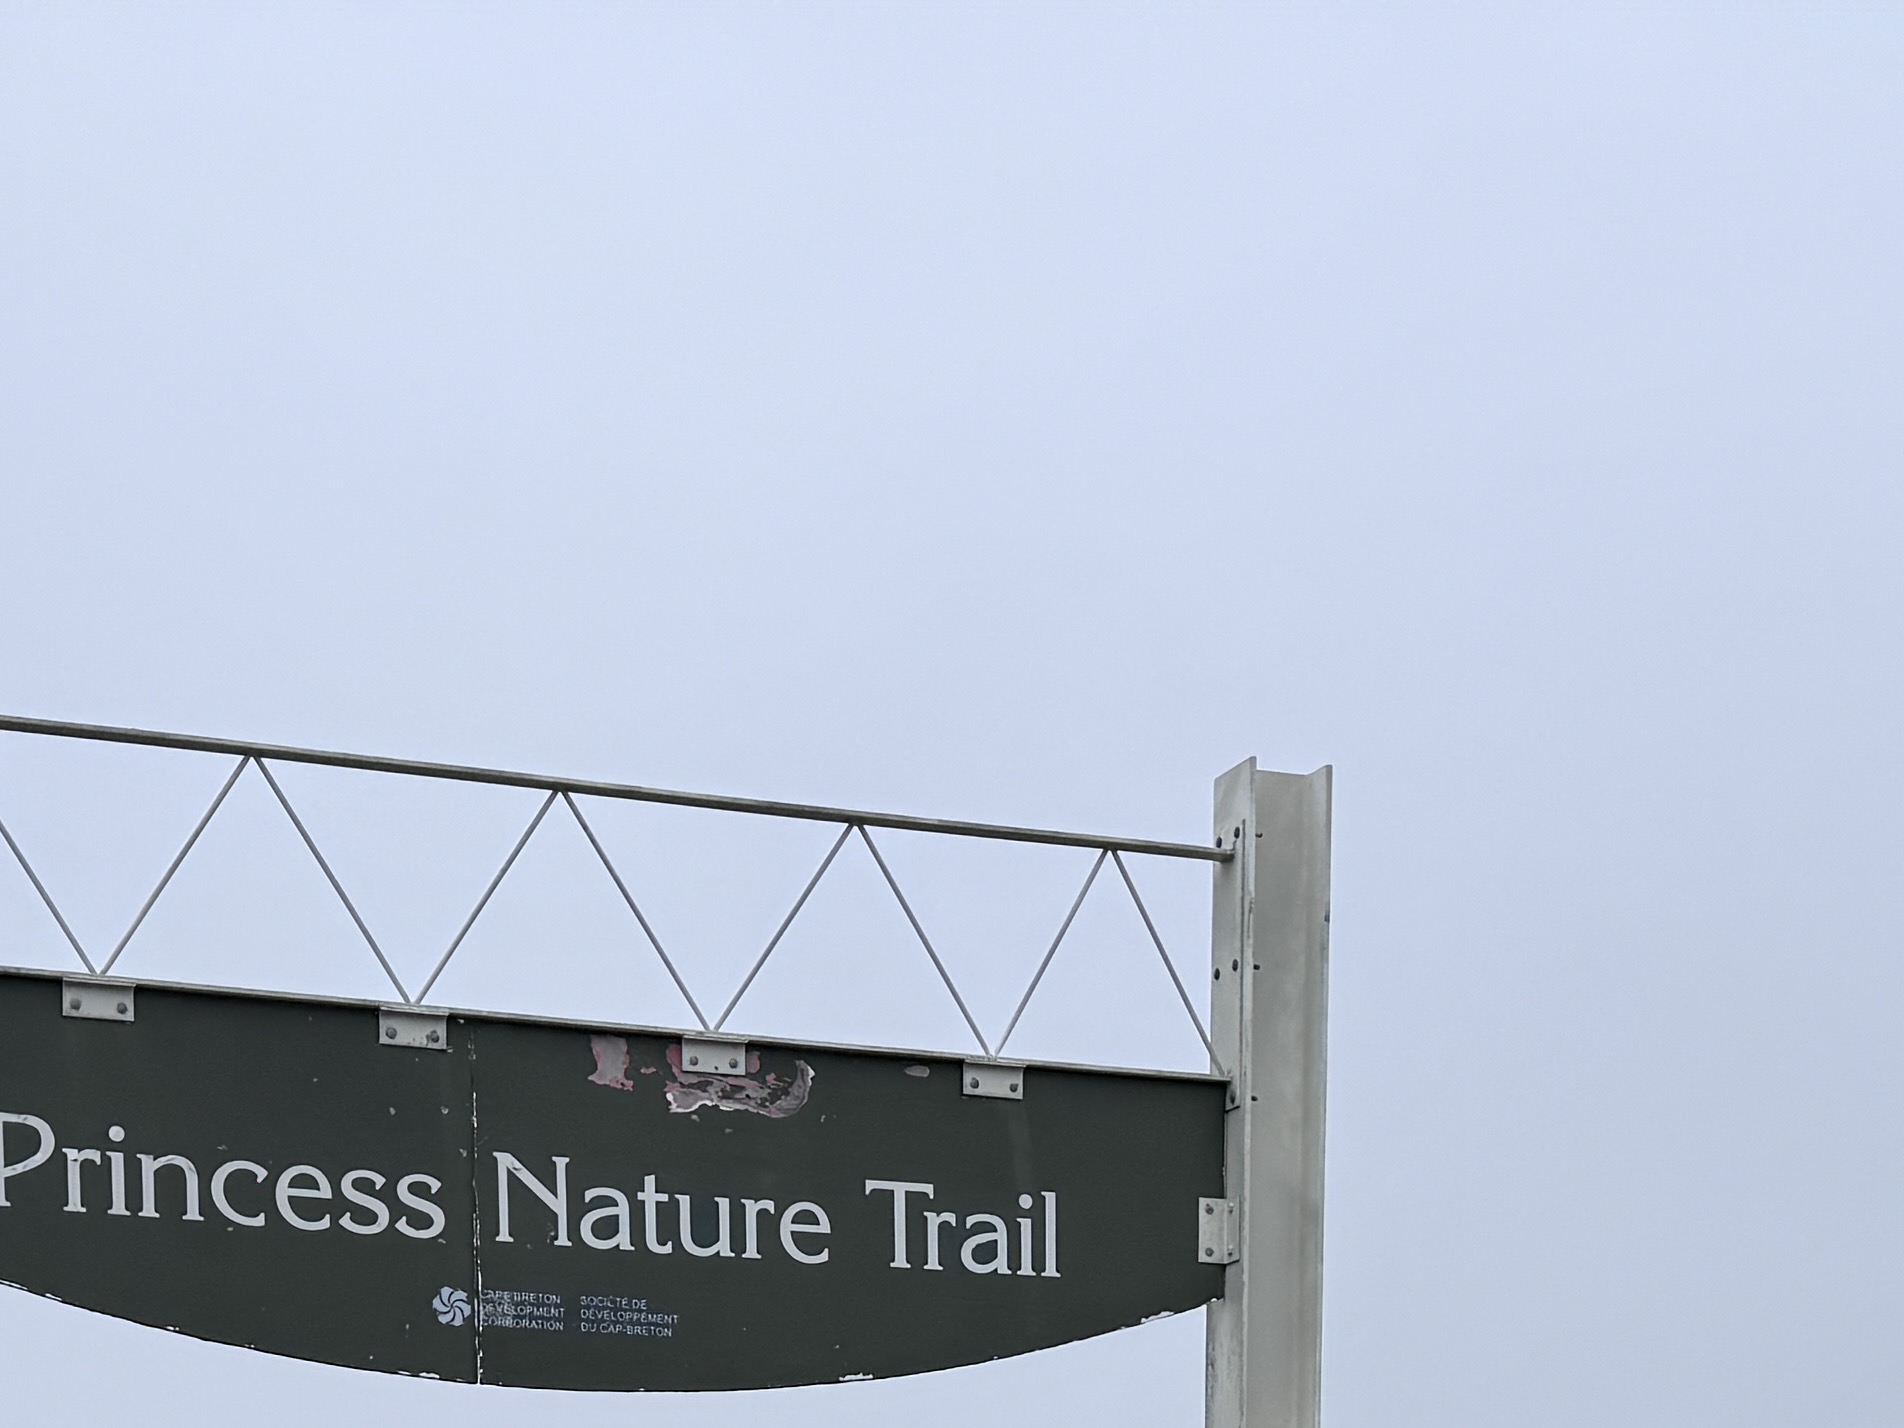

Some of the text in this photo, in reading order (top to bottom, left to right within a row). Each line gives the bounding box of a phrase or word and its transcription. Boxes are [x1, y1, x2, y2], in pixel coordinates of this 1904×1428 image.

[492, 1150, 832, 1265] Nature
[864, 1178, 1062, 1278] Trail
[513, 1291, 561, 1304] BRETON
[632, 1299, 647, 1310] DE
[580, 1321, 673, 1337] DU CAP-BRETON
